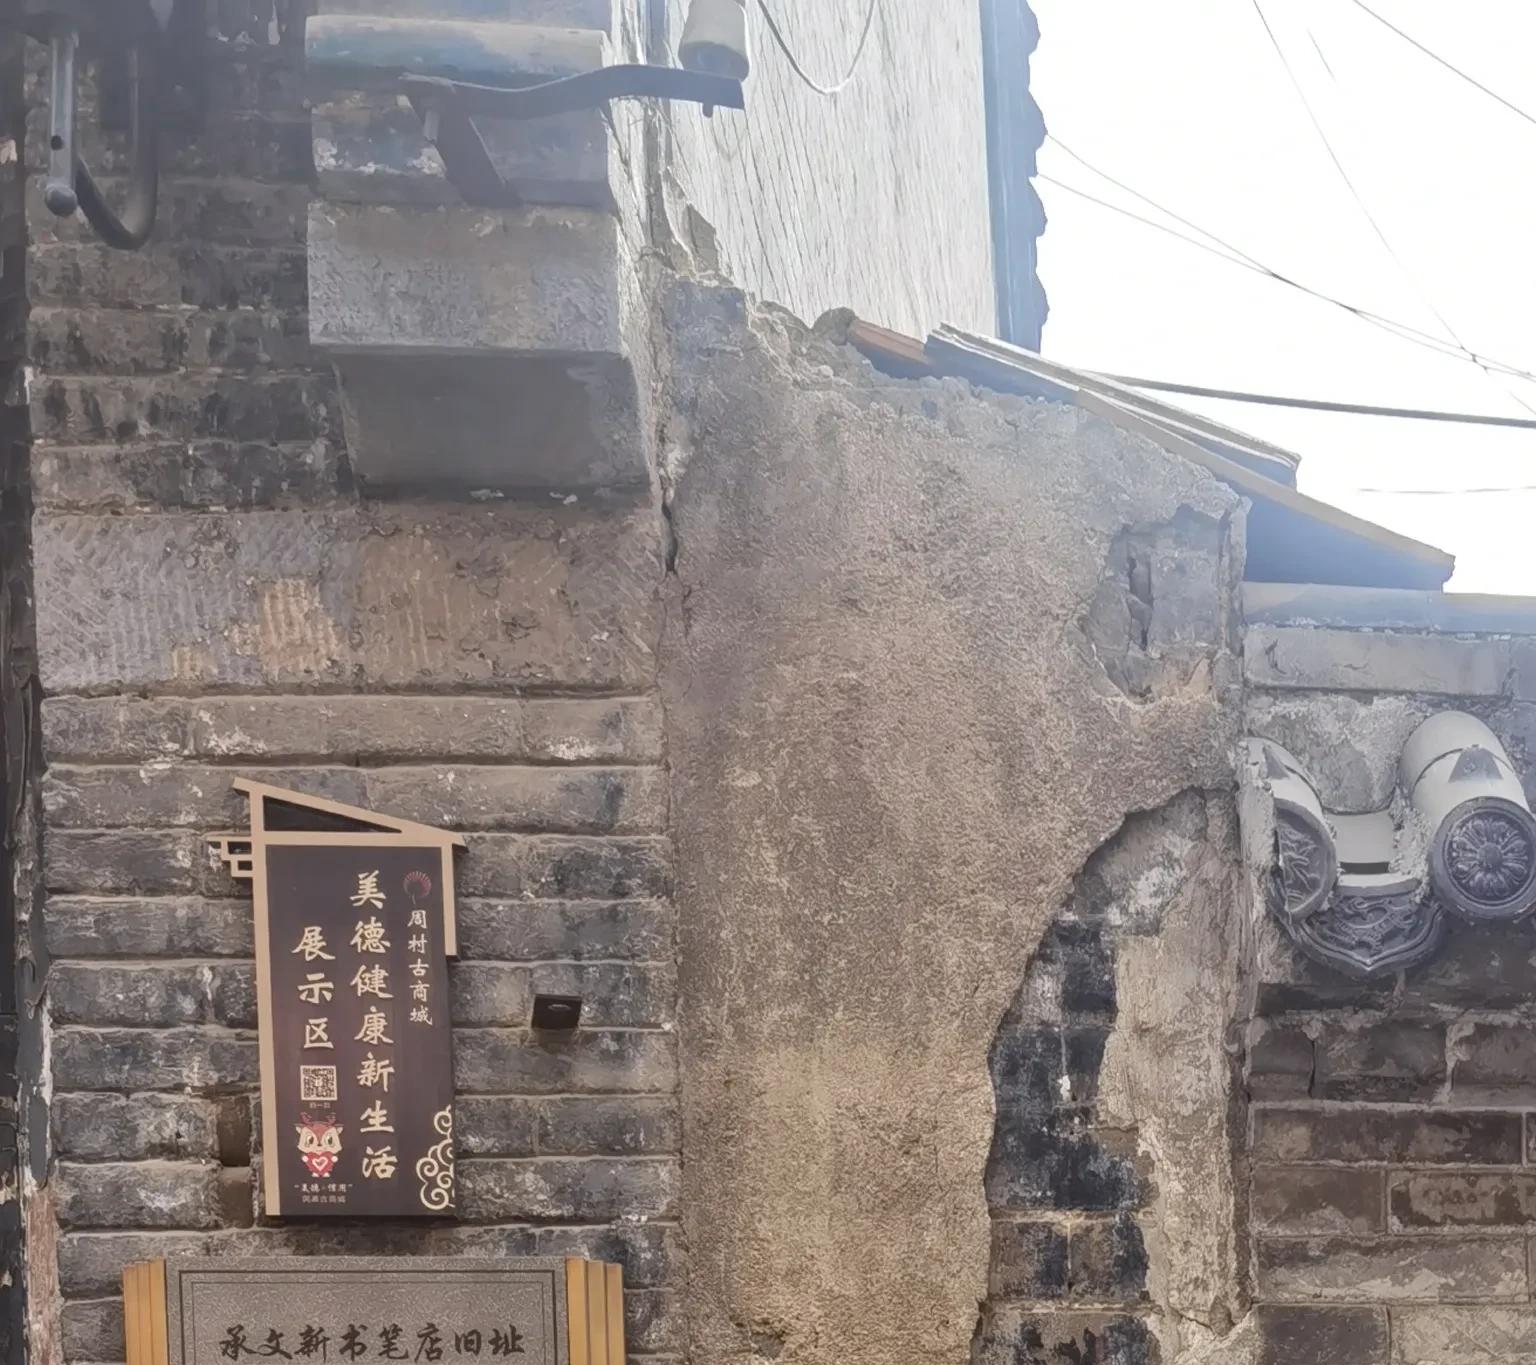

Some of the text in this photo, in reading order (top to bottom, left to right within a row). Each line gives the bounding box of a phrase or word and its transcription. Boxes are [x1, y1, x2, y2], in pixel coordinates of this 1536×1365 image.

[292, 925, 336, 1050] 展示区
[350, 870, 398, 1180] 美德健康新生活
[407, 909, 433, 1026] 周村古商城
[219, 1322, 525, 1363] 承文新书笔店旧址
